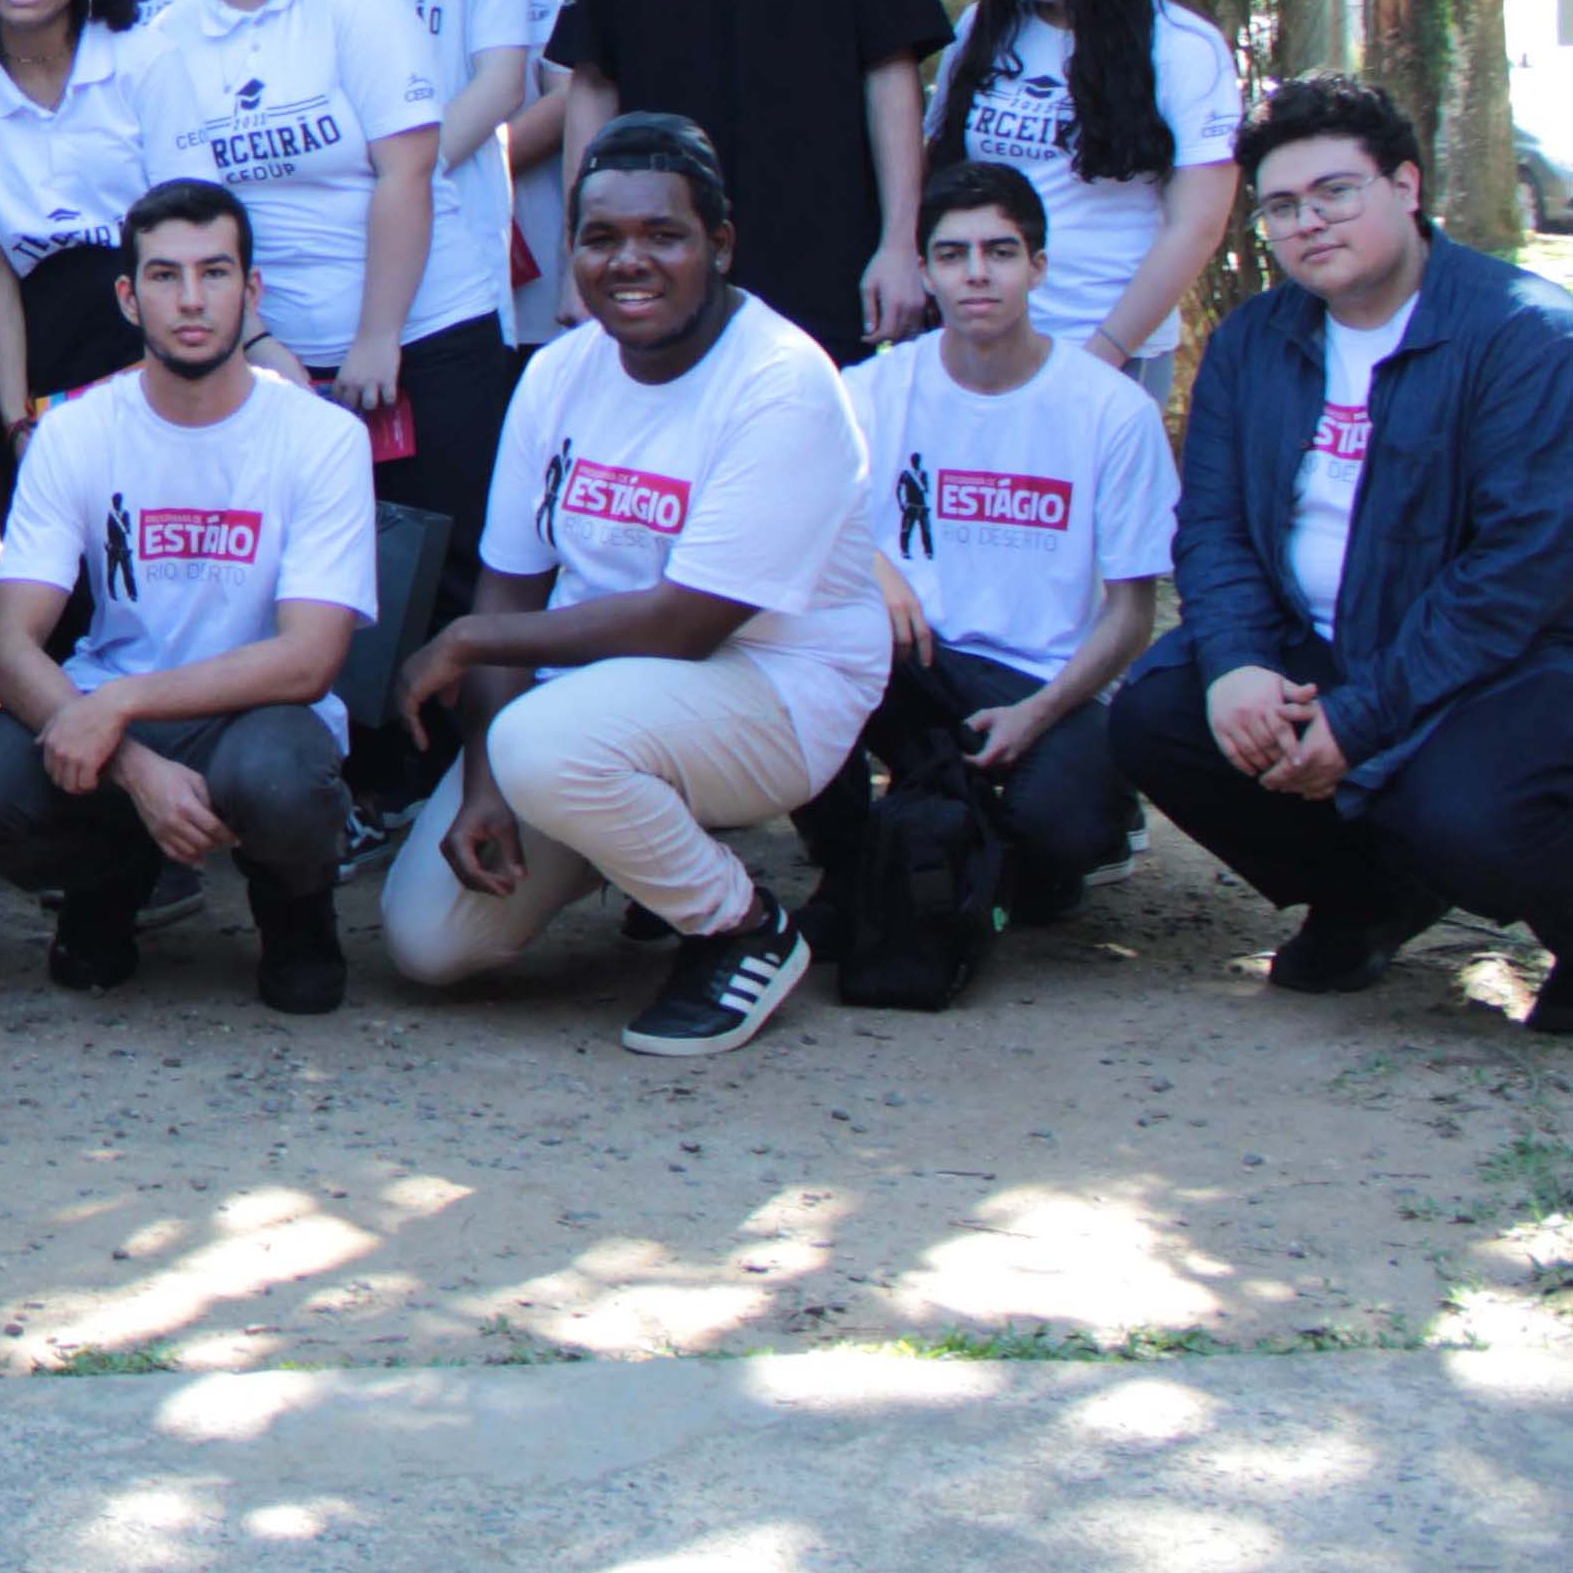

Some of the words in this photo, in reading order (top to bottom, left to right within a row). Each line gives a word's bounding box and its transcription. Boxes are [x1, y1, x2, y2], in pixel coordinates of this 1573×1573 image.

[210, 114, 342, 169] RCEIRÃO
[567, 474, 681, 528] ESTÁGIO
[942, 478, 1065, 524] ESTÁGIO
